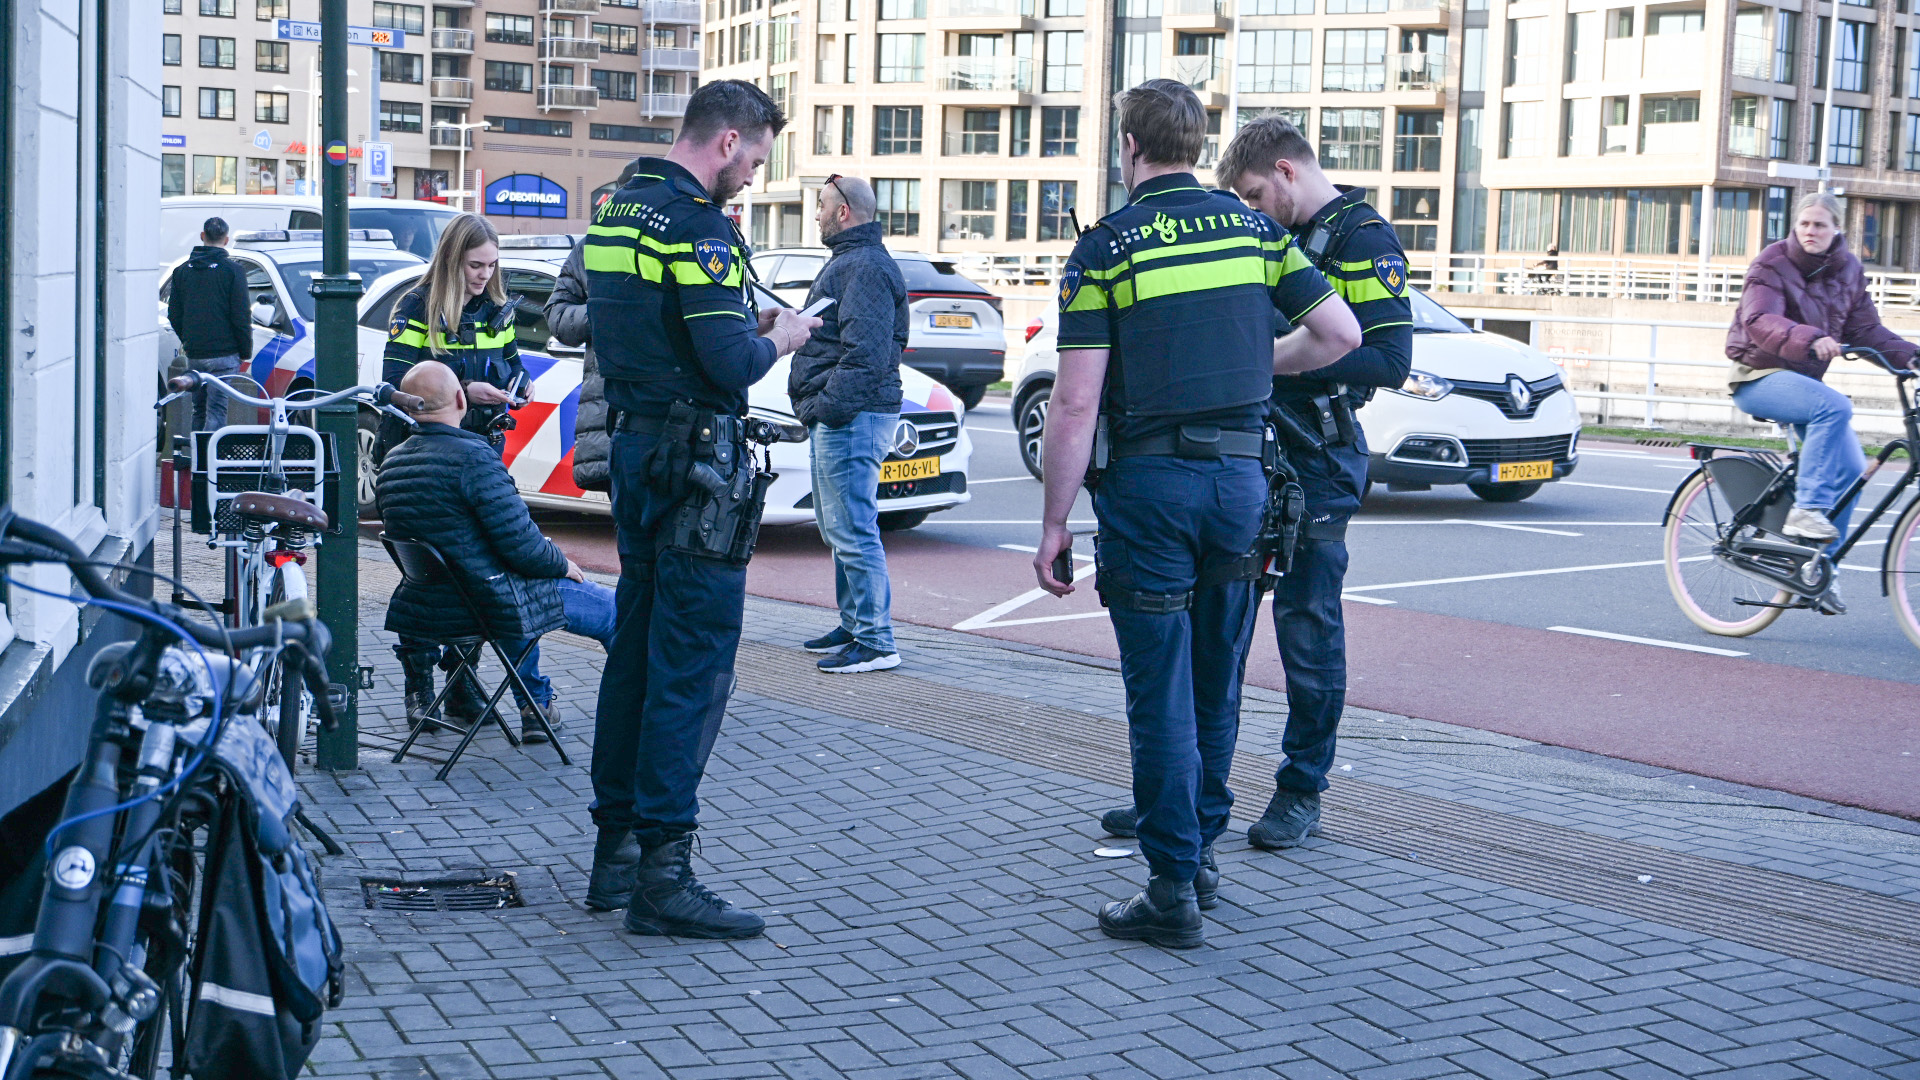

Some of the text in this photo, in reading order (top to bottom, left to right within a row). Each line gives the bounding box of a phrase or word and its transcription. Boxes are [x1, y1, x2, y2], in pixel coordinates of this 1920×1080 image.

[372, 31, 391, 43] 282
[509, 191, 561, 204] DECATHLON
[1140, 213, 1243, 244] POLITIE
[698, 244, 728, 253] POLITIE
[1377, 260, 1403, 269] POLITIE
[884, 461, 935, 479] R-106-VL
[1501, 464, 1549, 479] H-702-XV
